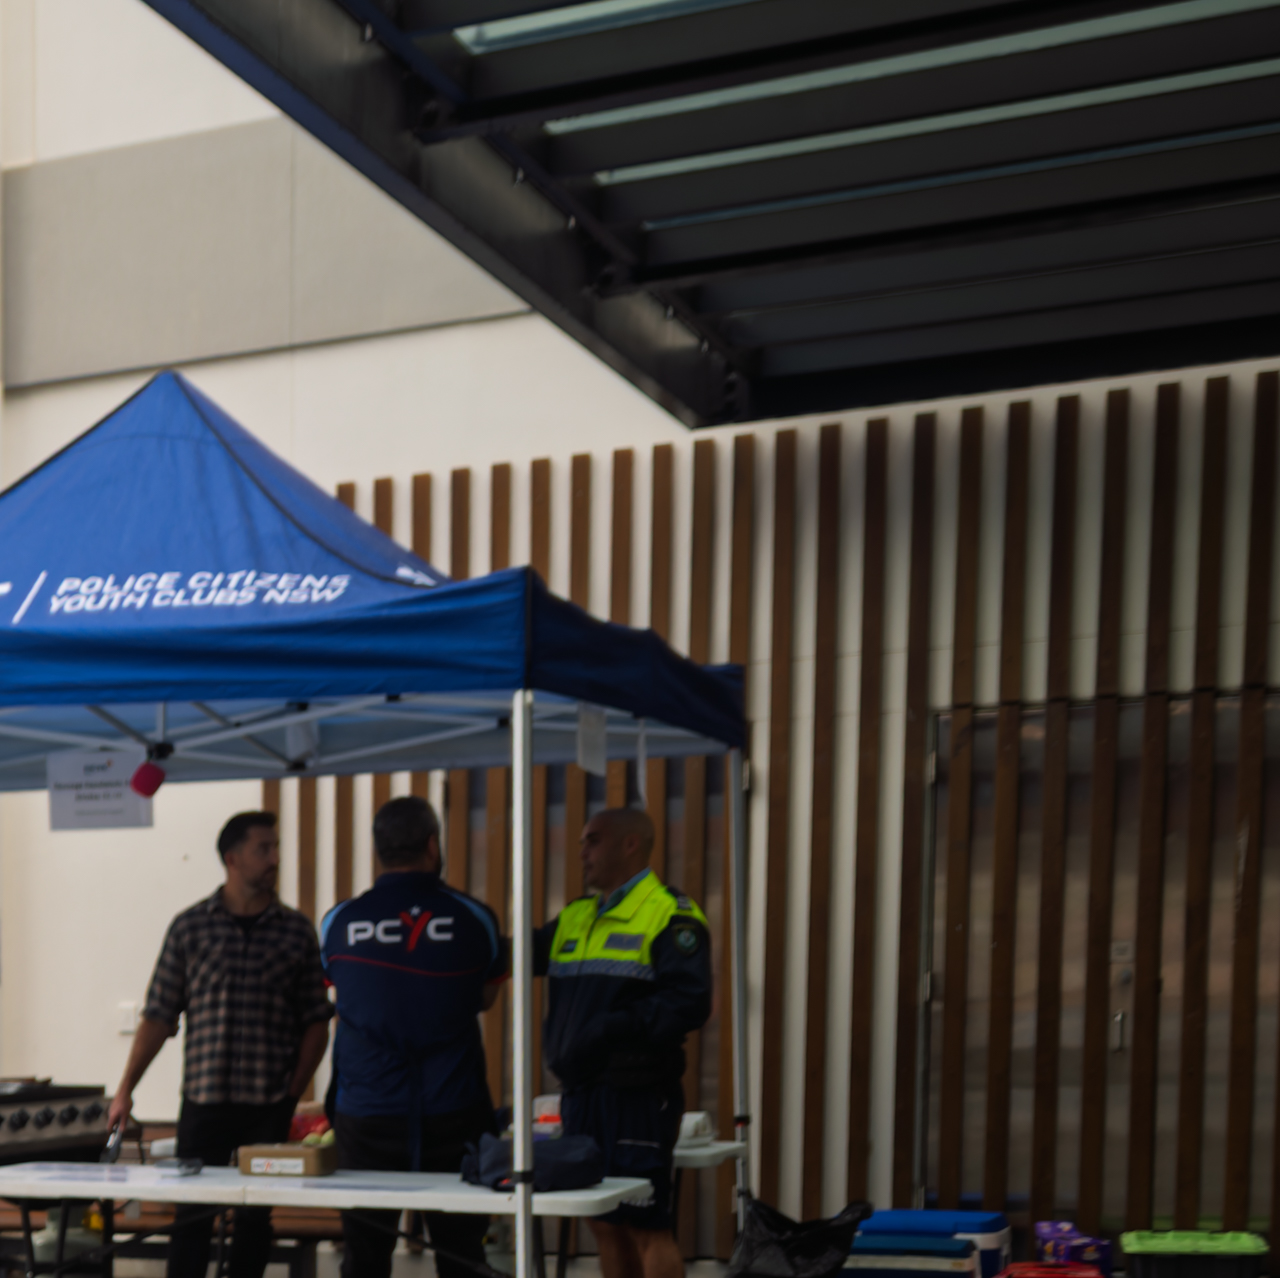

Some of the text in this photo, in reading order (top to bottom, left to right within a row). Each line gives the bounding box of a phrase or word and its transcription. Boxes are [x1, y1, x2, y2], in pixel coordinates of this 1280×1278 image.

[56, 571, 182, 596] POLICE
[187, 569, 353, 591] CITIZENS
[49, 586, 348, 615] YOUTH CLUBS NSW
[347, 910, 454, 953] PCYC
